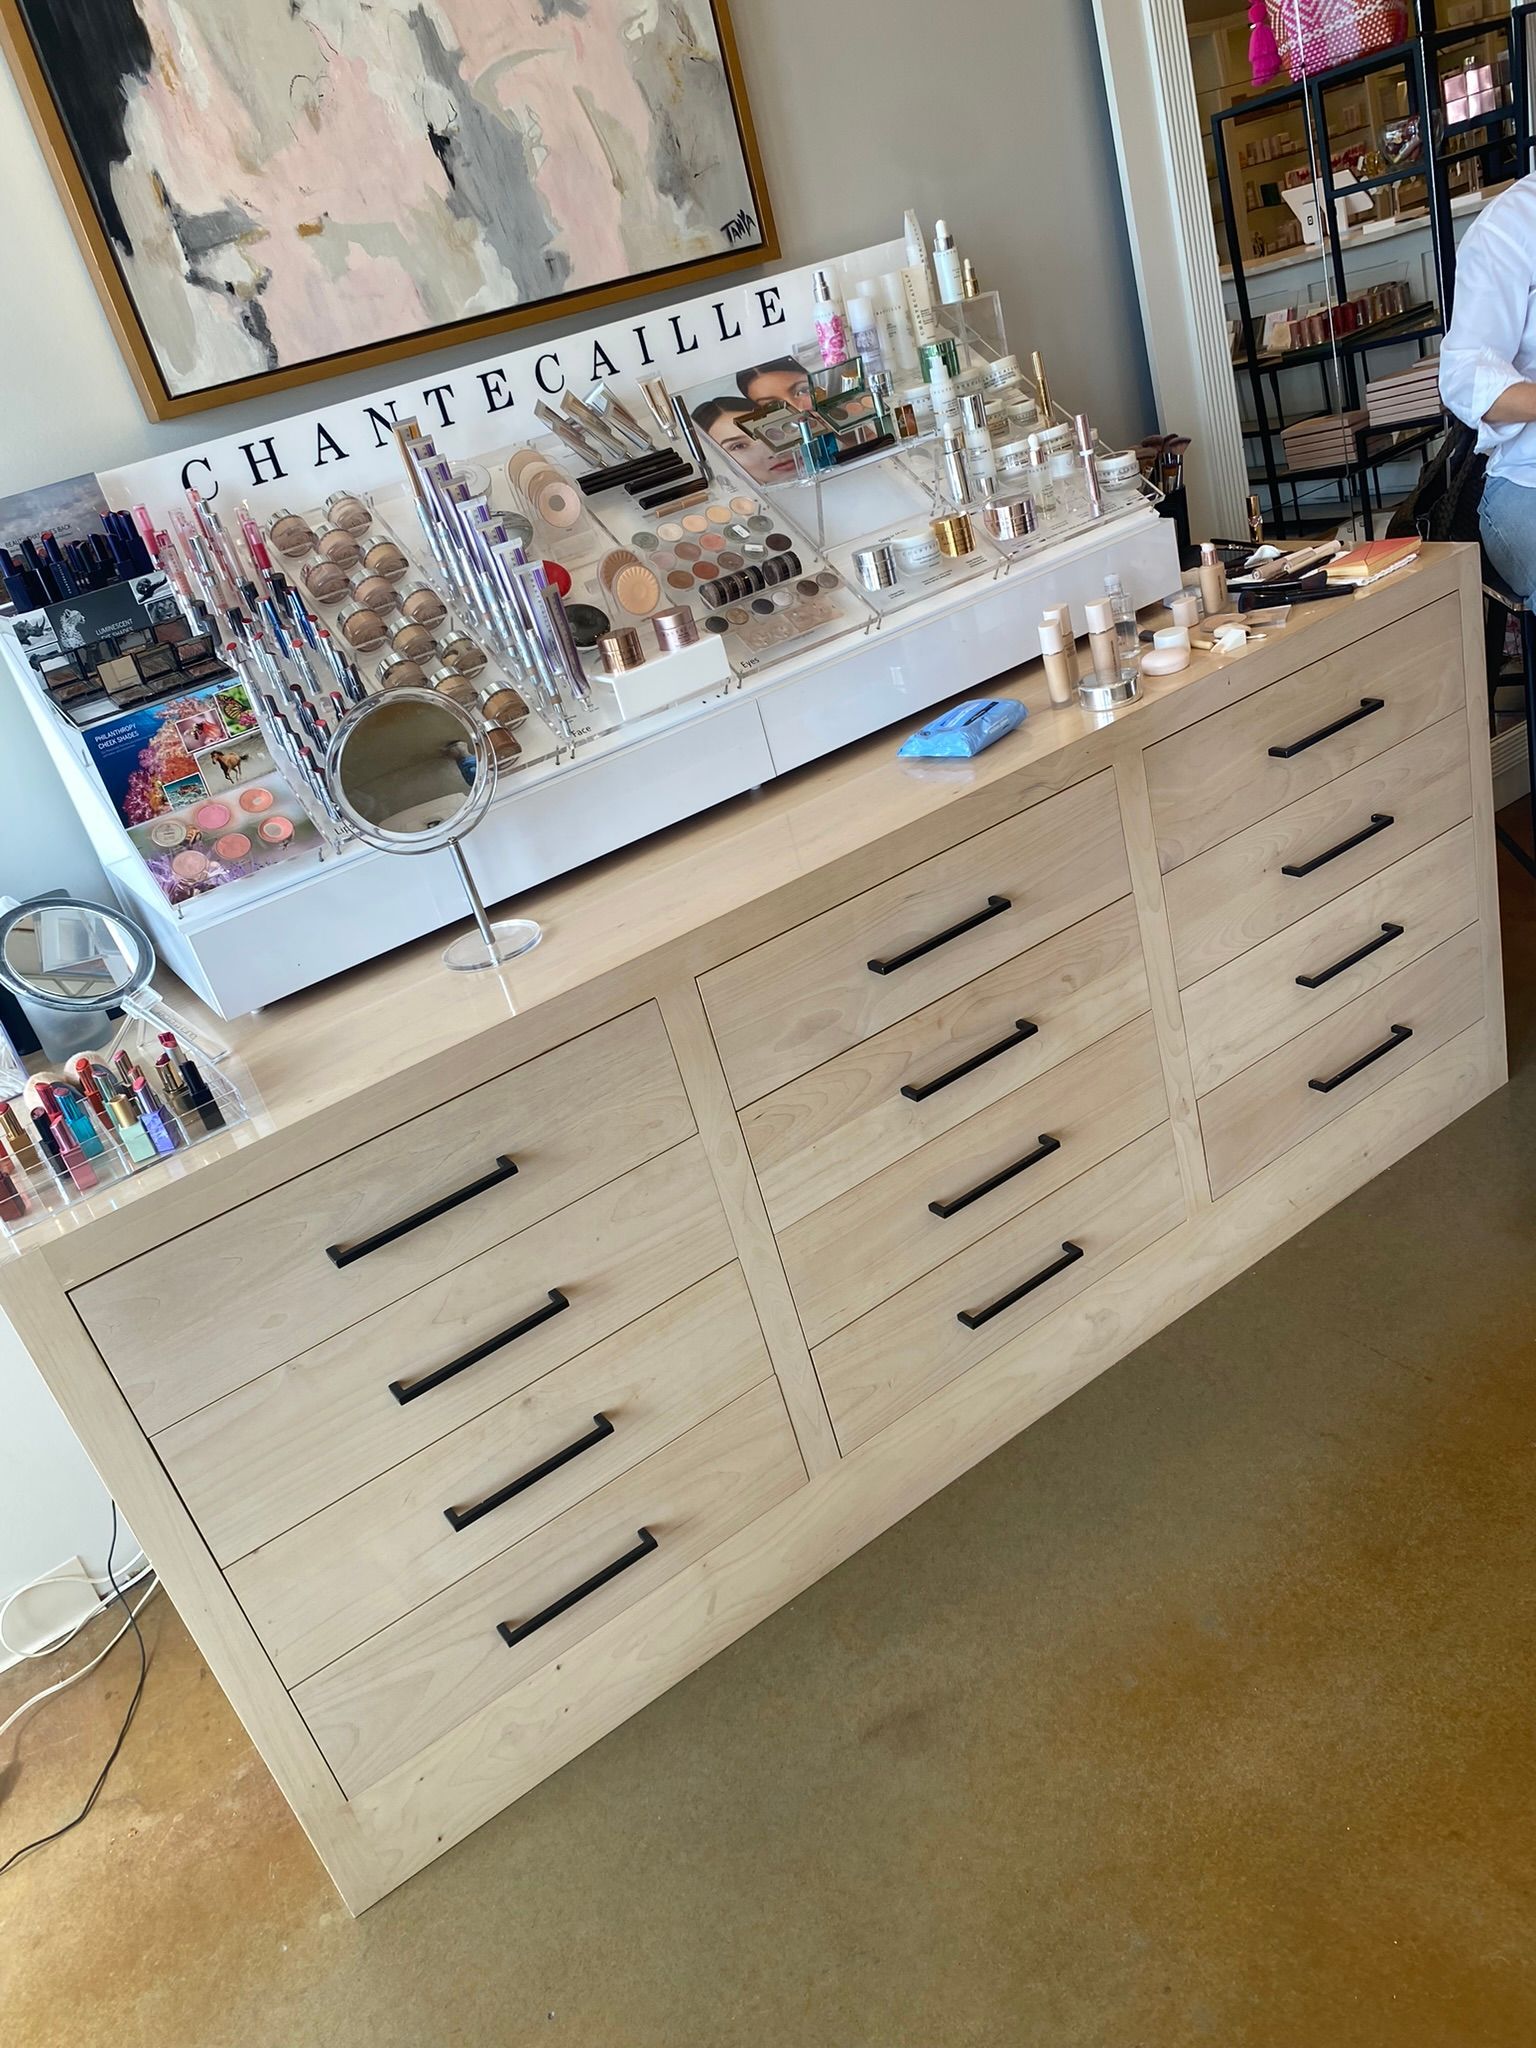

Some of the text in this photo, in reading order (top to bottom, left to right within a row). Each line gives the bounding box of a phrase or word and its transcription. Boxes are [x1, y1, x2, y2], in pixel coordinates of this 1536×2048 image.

[181, 286, 786, 500] CHANTECAILLE
[95, 618, 133, 636] LUMINESCENT
[740, 657, 760, 669] Eyes
[94, 723, 136, 742] PHILANTHROPY
[97, 739, 118, 750] CHEEK
[116, 731, 139, 744] SHADES
[571, 726, 592, 737] Face
